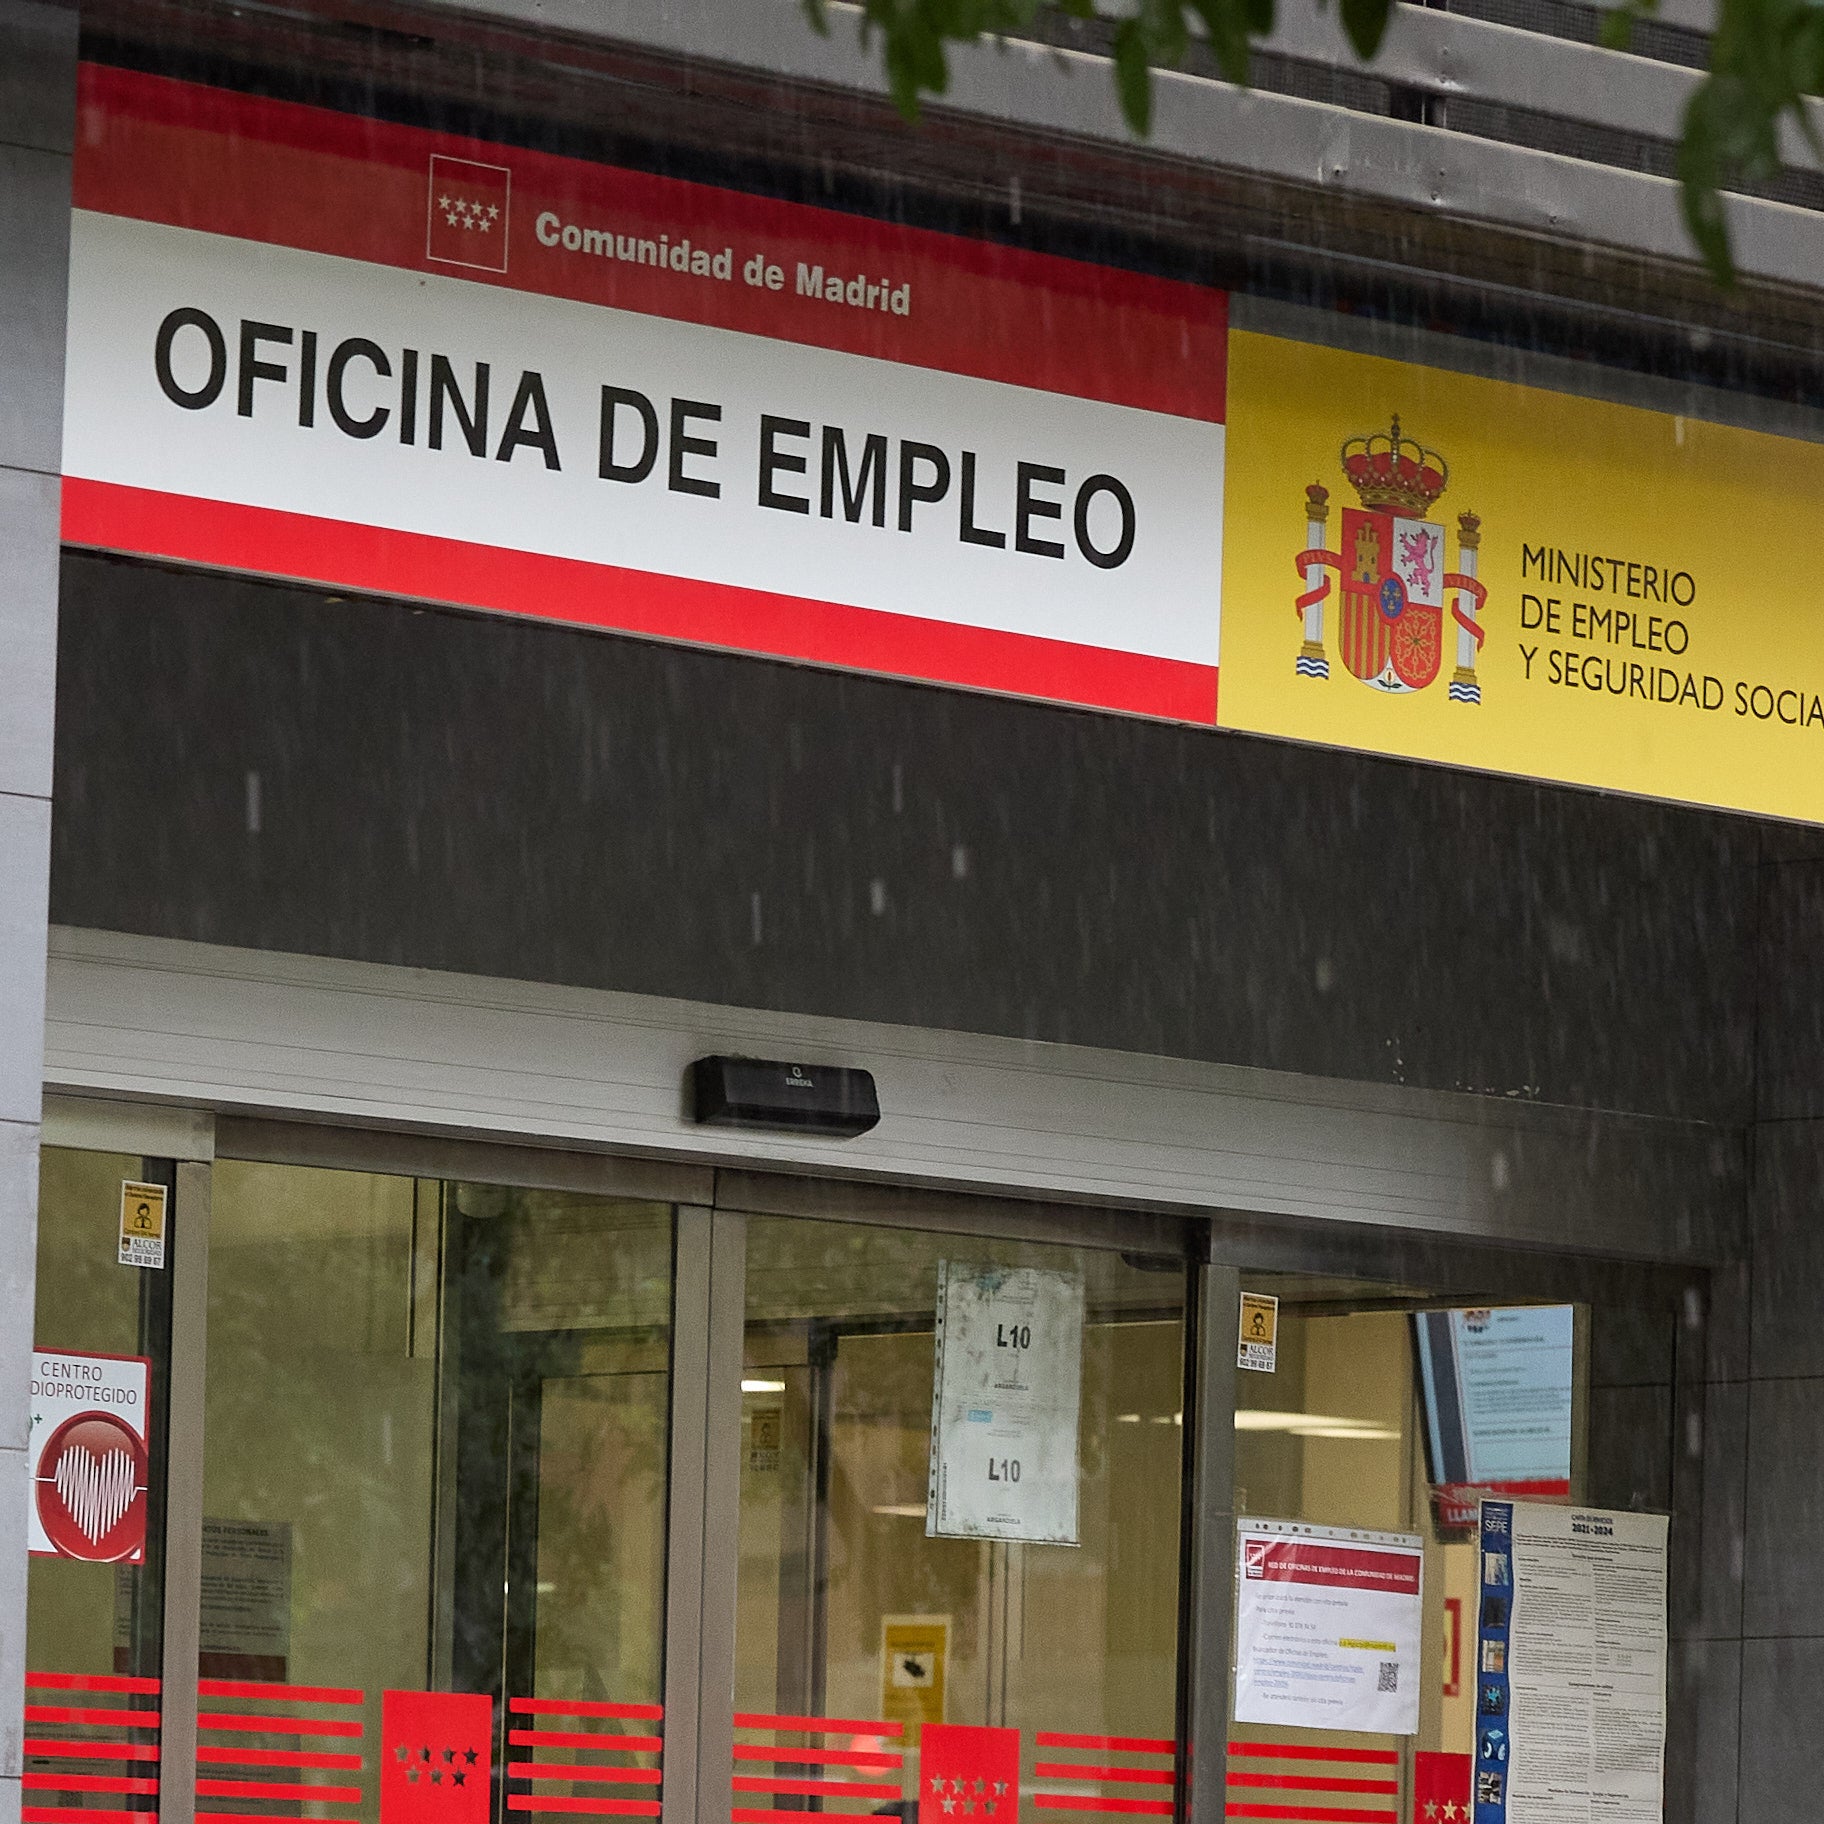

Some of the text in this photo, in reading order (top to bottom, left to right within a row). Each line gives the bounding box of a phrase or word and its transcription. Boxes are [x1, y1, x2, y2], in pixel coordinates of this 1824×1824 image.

[535, 212, 911, 317] Comunidad de Madrid
[154, 307, 1136, 569] OFICINA DE EMPLEO
[1522, 544, 1696, 607] MINISTERIO
[1522, 594, 1689, 655] DE EMPLEO
[1519, 644, 1538, 679] Y
[1549, 649, 1723, 713] SEGURIDAD
[997, 1324, 1030, 1349] L10
[41, 1362, 102, 1381] CENTRO
[989, 1458, 1020, 1482] L10
[1485, 1520, 1507, 1532] SEPE
